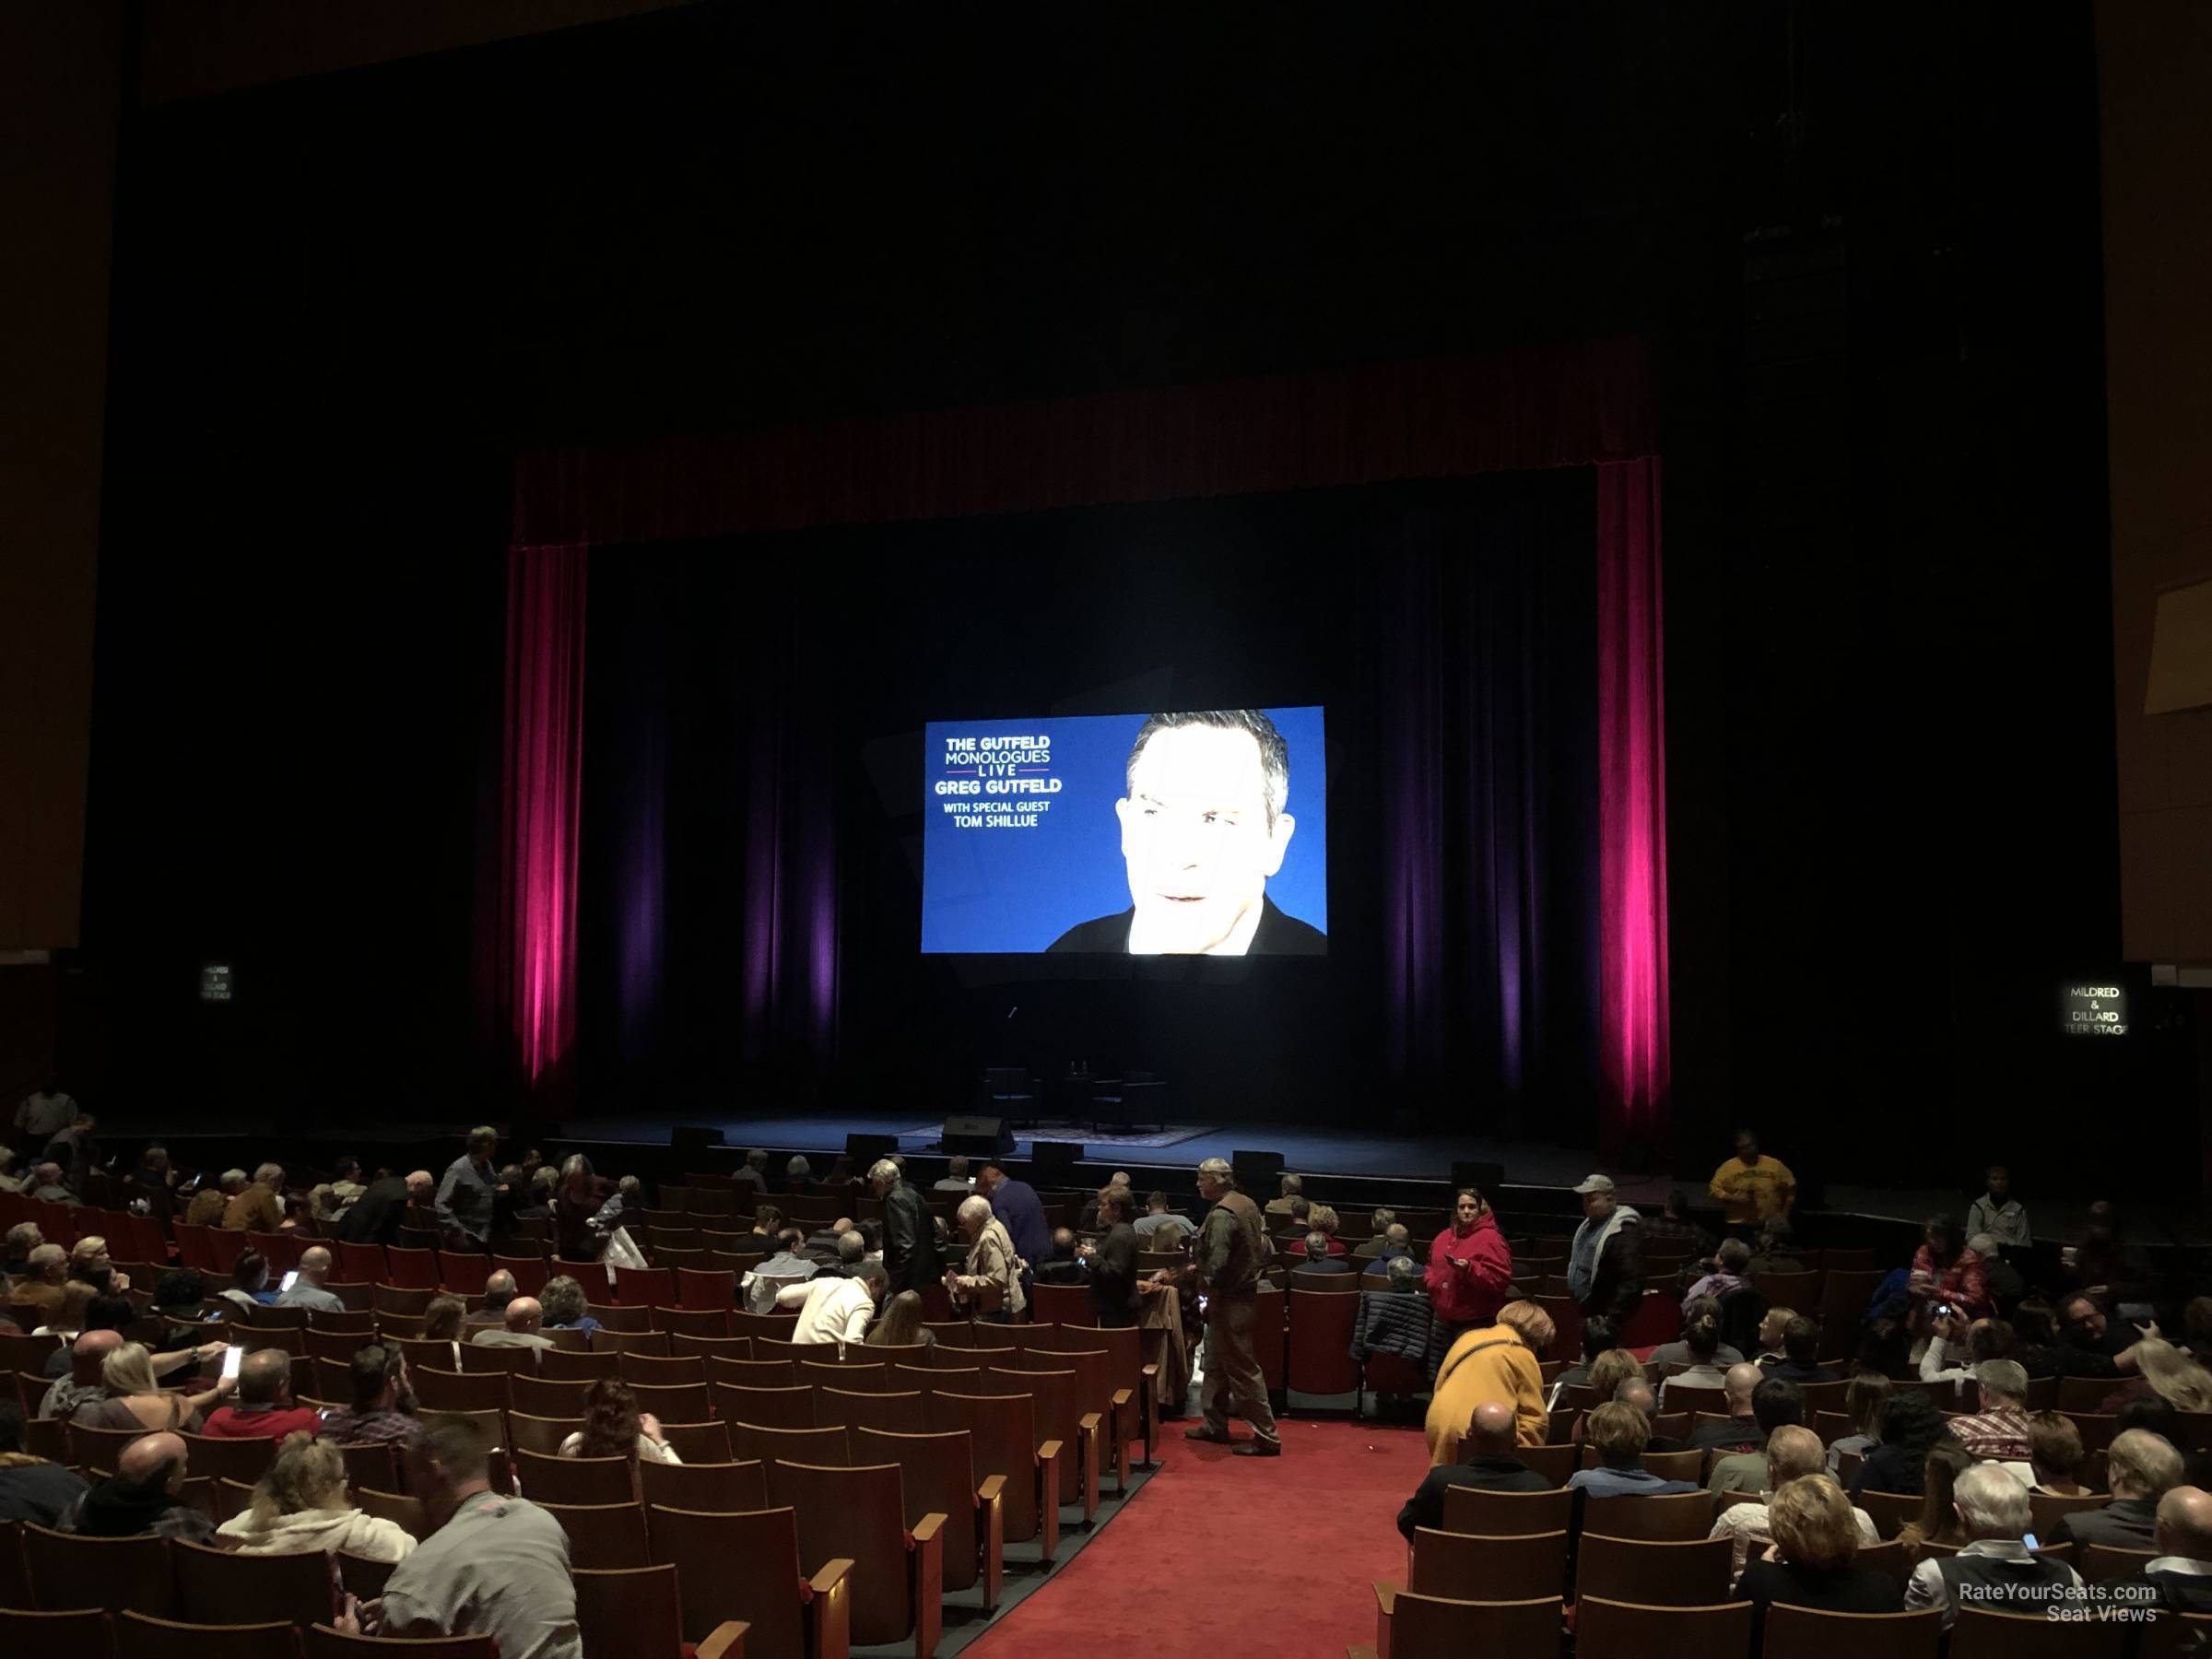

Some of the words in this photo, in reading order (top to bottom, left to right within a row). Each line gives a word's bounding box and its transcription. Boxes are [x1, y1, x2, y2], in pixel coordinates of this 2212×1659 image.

[946, 738, 976, 751] THE
[980, 736, 1051, 750] GUTFELD
[946, 750, 1051, 765] MONOLOGUES
[978, 764, 1017, 777] LIVE
[935, 781, 982, 794] GREG
[985, 779, 1063, 794] GUTFELD
[944, 803, 971, 813] WITH
[972, 802, 1015, 812] SPECIAL
[1017, 801, 1051, 812] GUEST
[954, 816, 982, 828] TOM
[986, 815, 1038, 827] SHILLUE
[2070, 987, 2120, 998] MILDRED
[2090, 999, 2100, 1009] &
[2072, 1011, 2119, 1022] DILLARD
[2093, 1025, 2129, 1036] STAGE
